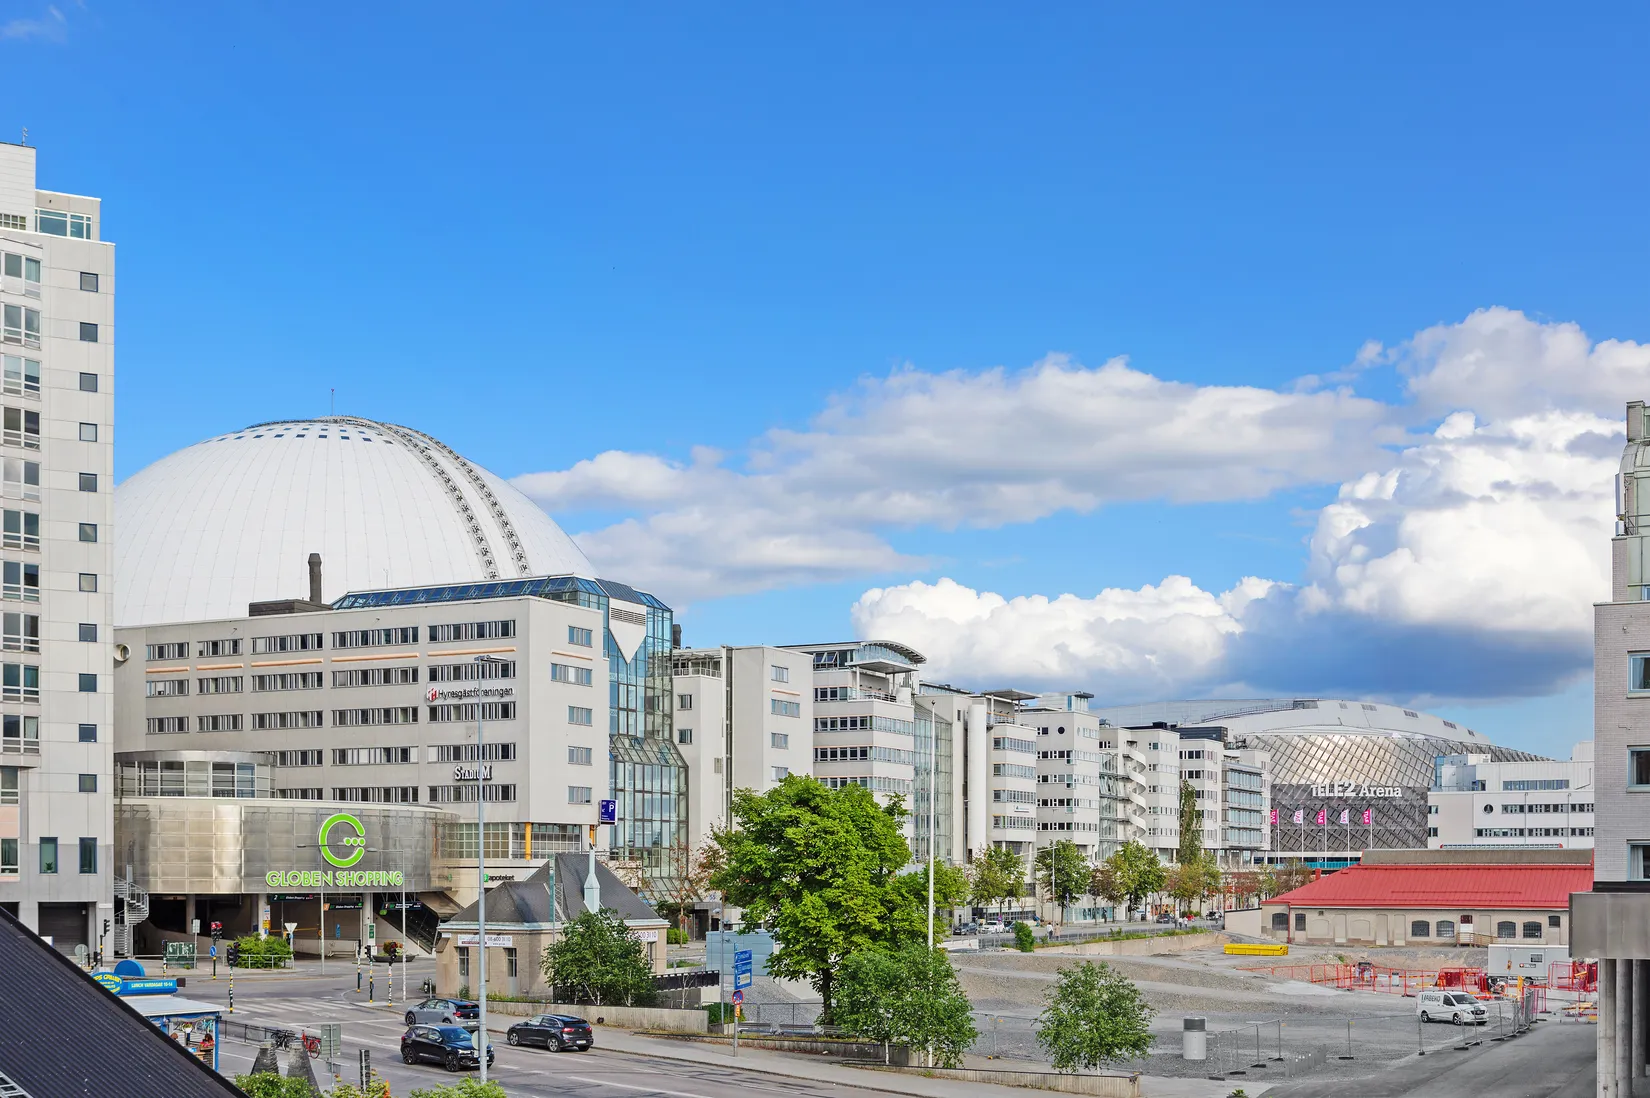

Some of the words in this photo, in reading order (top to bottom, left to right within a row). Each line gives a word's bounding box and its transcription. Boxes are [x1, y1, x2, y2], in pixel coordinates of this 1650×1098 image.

[1310, 780, 1356, 797] TELE2
[1358, 783, 1403, 797] Arena
[265, 870, 333, 887] GLOBEN
[335, 870, 403, 887] SHOPPING
